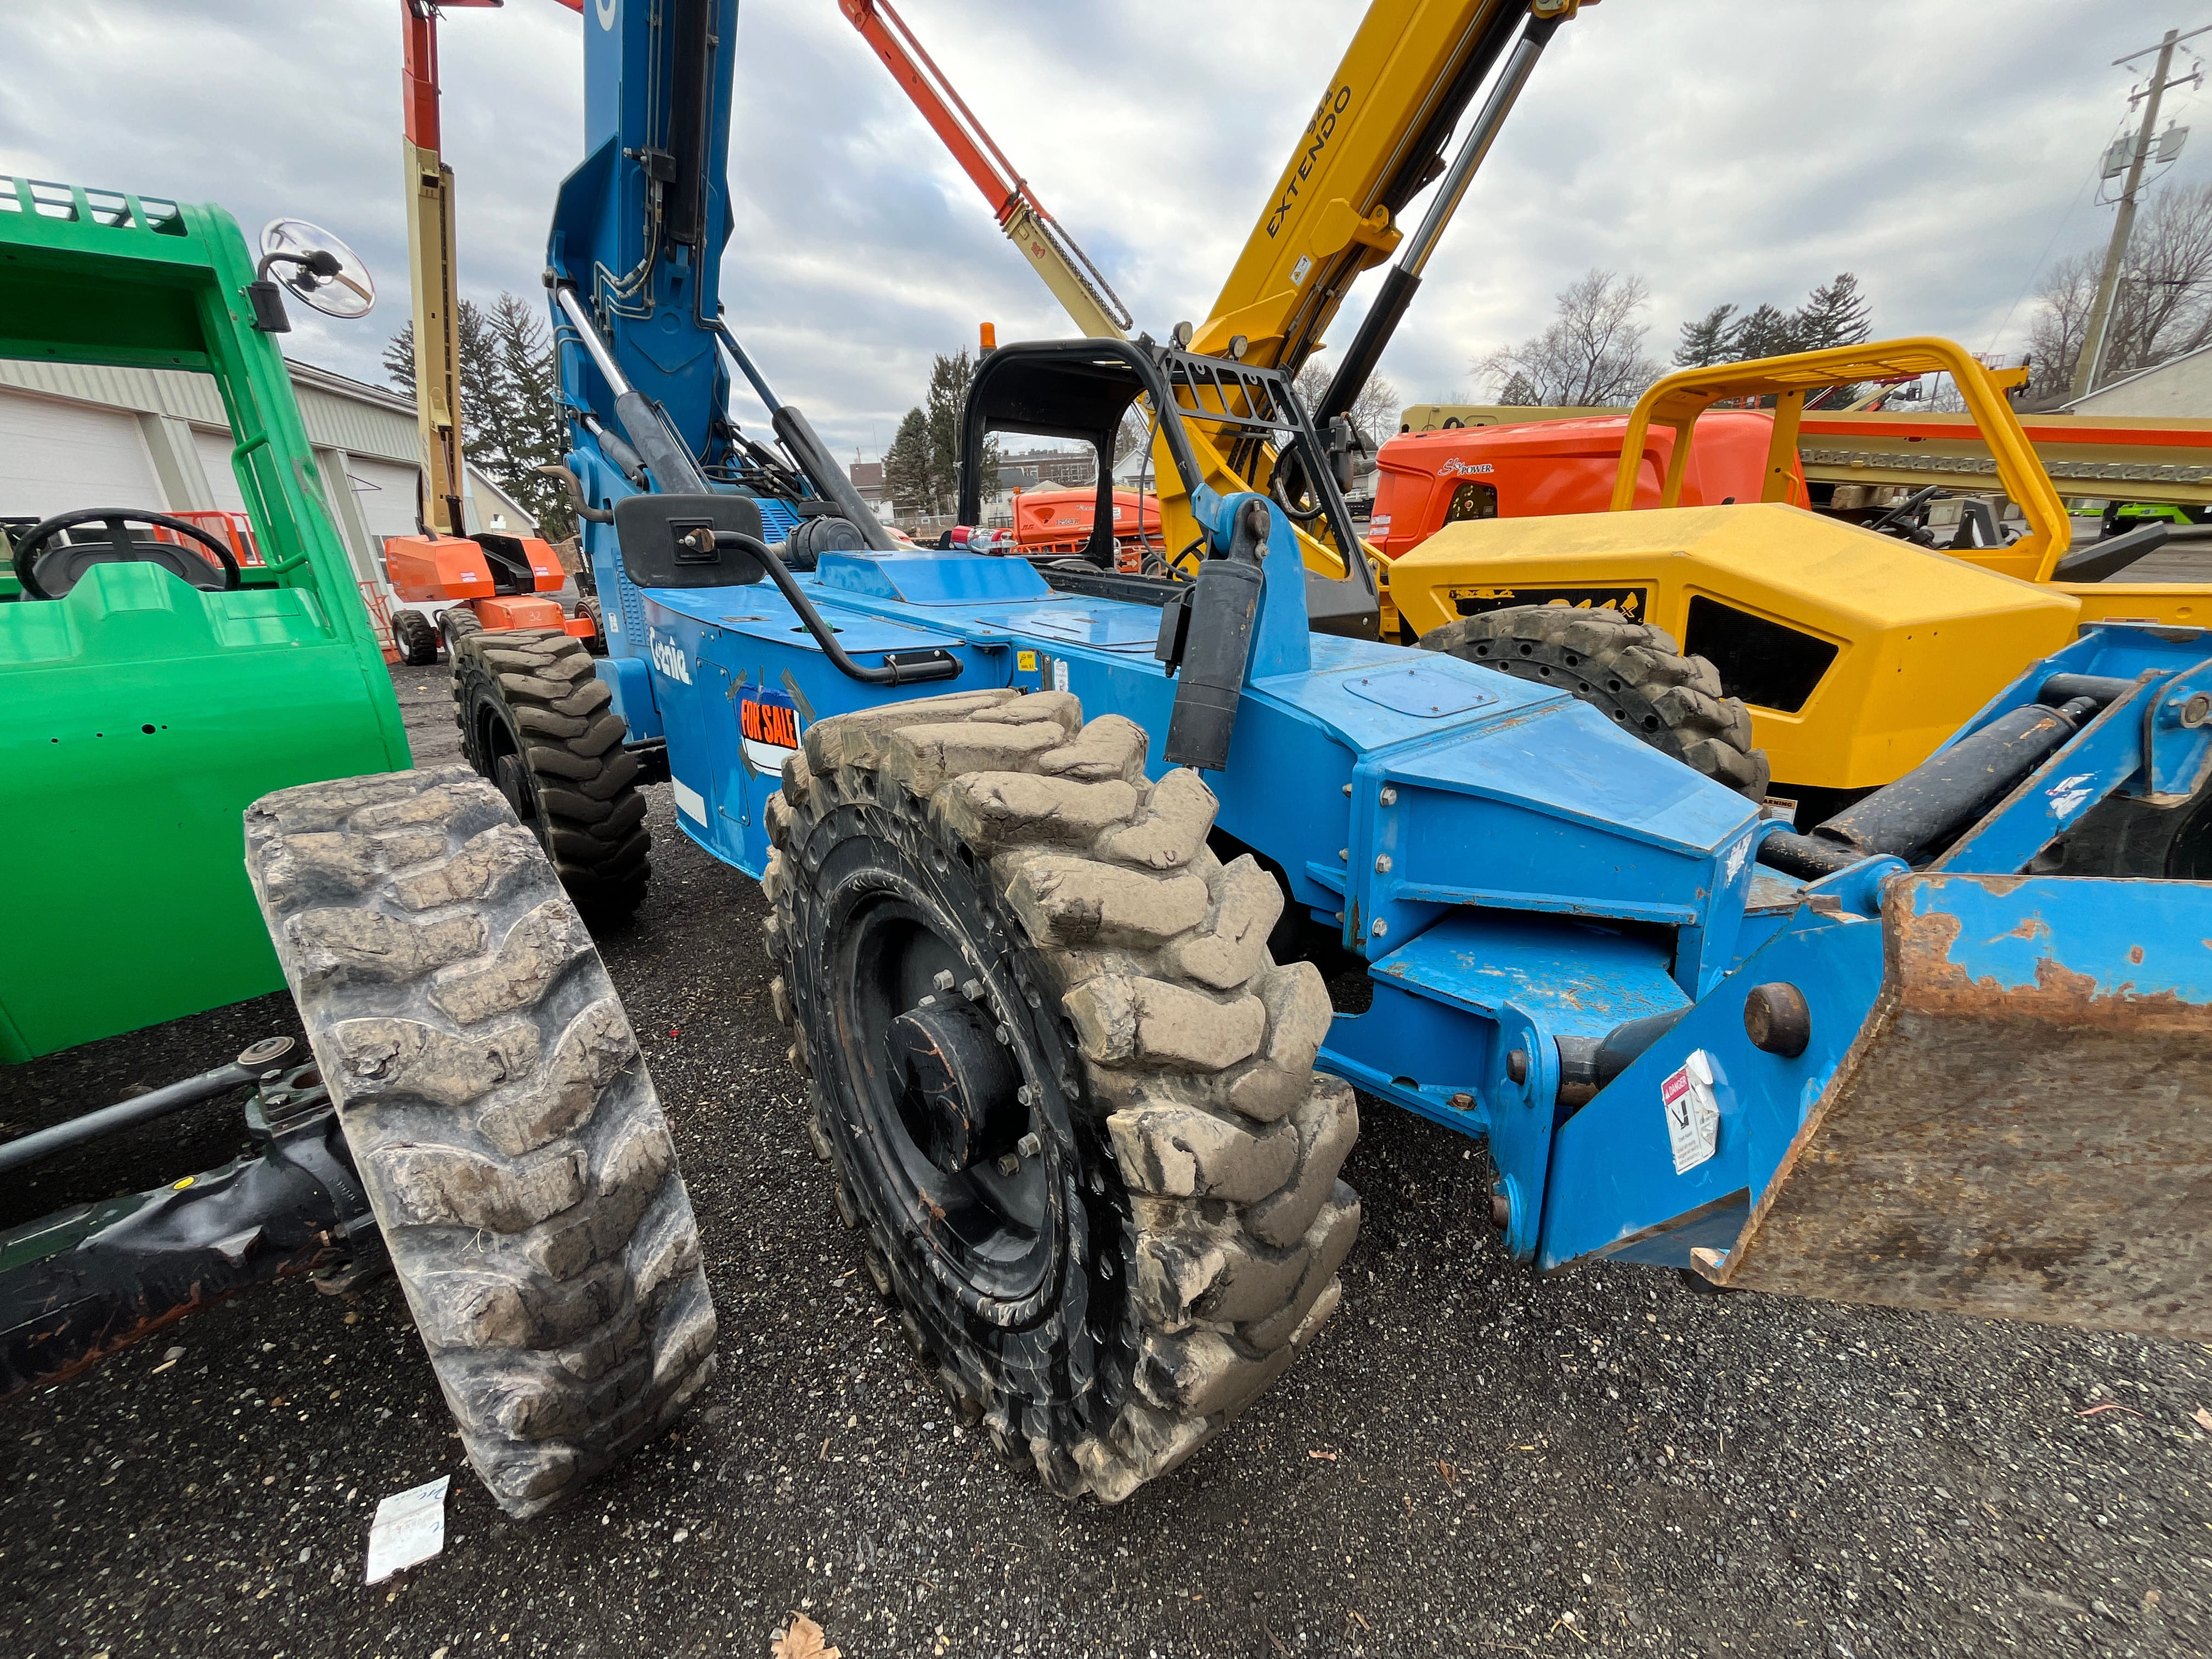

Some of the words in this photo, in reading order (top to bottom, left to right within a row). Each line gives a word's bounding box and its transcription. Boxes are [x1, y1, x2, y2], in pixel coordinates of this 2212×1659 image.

[1266, 85, 1351, 239] EXTENDO
[529, 610, 543, 622] 32
[741, 699, 762, 741] FOR
[761, 704, 797, 748] SALE
[1763, 799, 1792, 807] ARNING
[1668, 1075, 1688, 1097] DANGER
